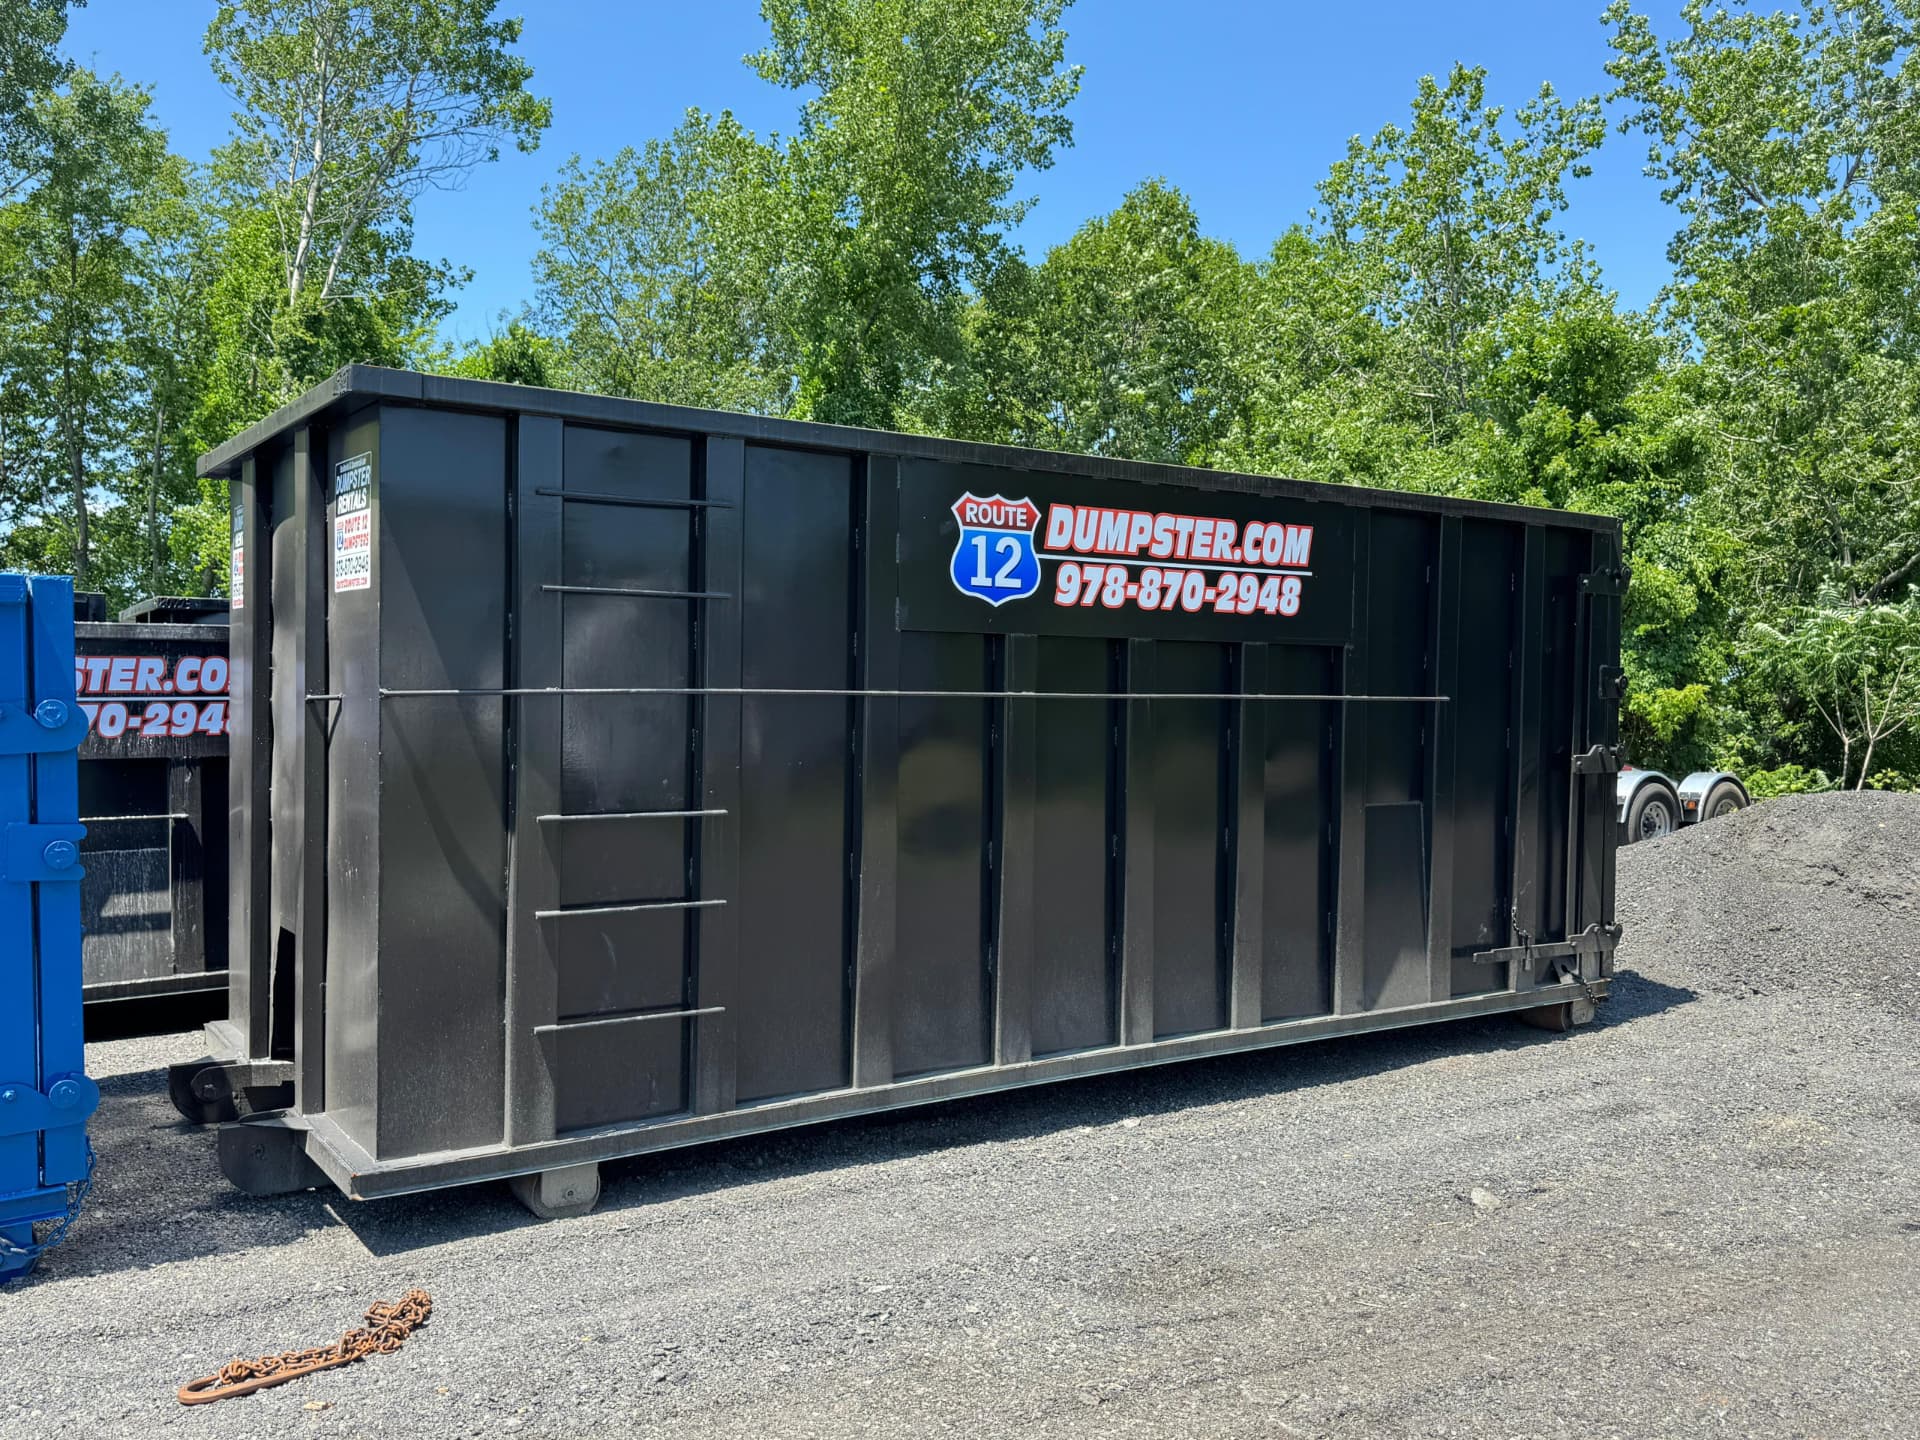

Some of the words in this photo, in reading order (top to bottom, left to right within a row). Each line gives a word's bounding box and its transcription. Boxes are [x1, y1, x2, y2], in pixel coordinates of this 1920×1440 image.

[336, 465, 371, 495] DUMPSTER
[337, 487, 367, 514] RENTALS
[965, 502, 1028, 528] ROUTE
[1044, 503, 1313, 567] DUMPSTER.COM
[970, 534, 1023, 589] 12
[1055, 562, 1302, 616] 978-870-2948
[76, 656, 230, 694] TER.CO
[78, 702, 230, 739] 70-294
